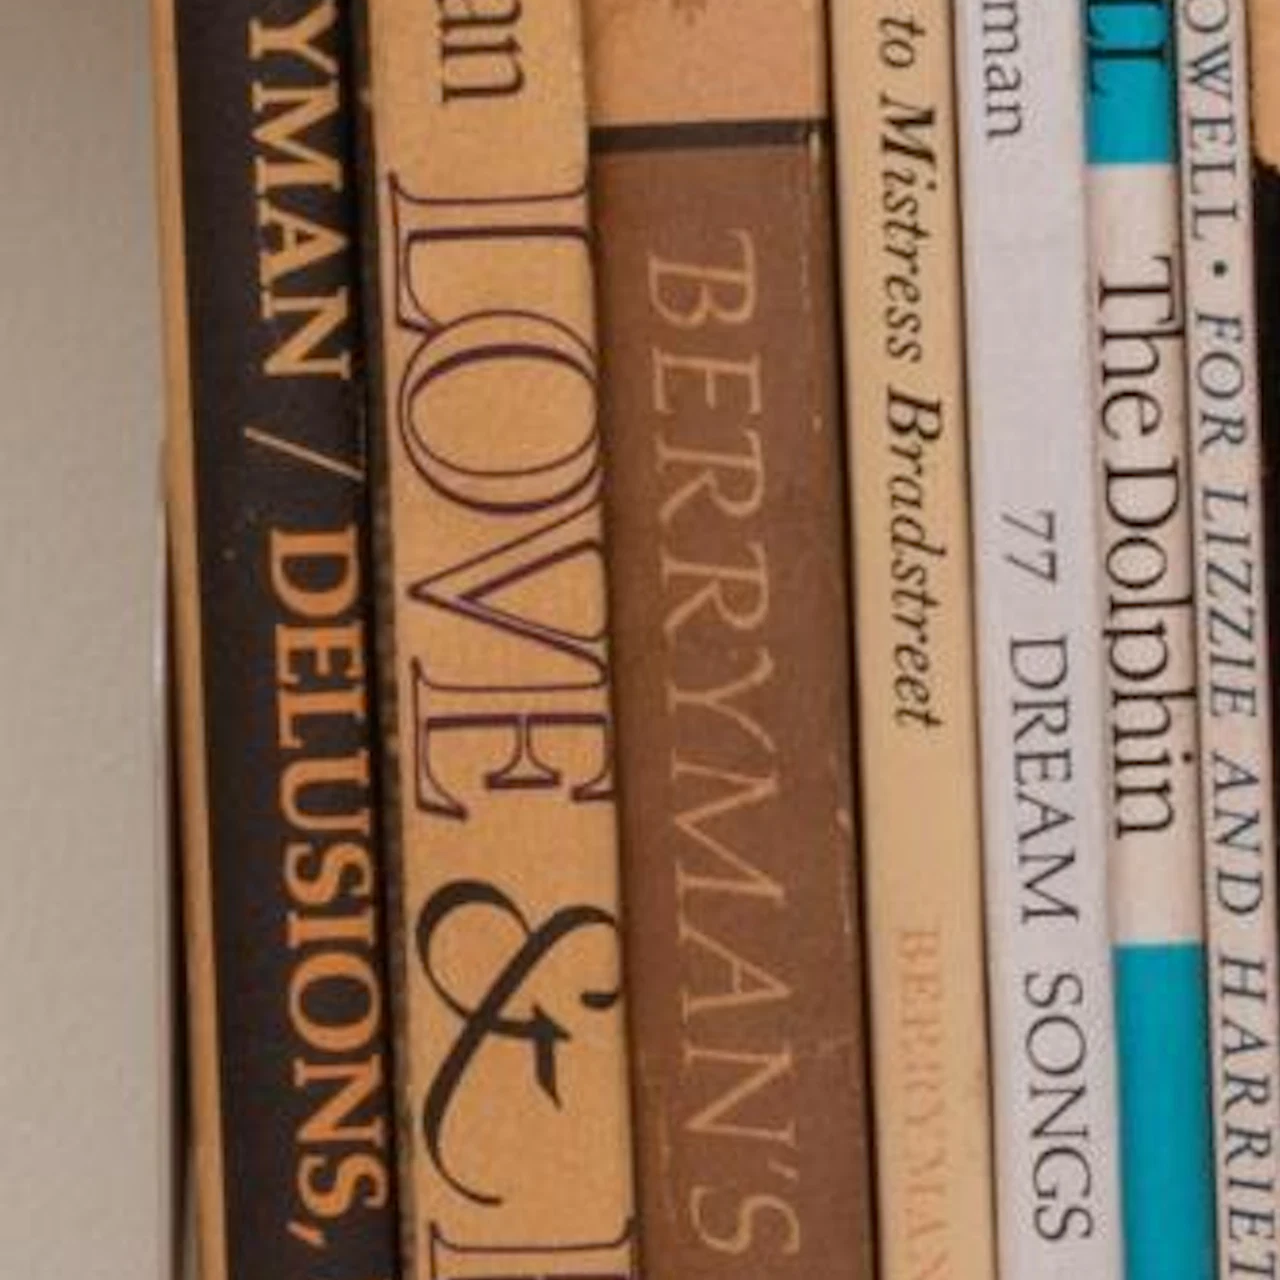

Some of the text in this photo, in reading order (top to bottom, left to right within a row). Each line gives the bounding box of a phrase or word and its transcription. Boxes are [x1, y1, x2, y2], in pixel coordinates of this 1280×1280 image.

[878, 13, 929, 67] to
[879, 94, 937, 364] Mistress
[1194, 310, 1248, 452] FOR
[387, 170, 614, 820] LOVE
[886, 382, 948, 730] Bradstreet
[1098, 255, 1200, 839] The Dolphin
[1202, 486, 1260, 720] LIZZIE
[268, 526, 388, 1245] DELUSIONS,
[647, 227, 800, 1254] BERRYMAN'S
[999, 508, 1094, 1243] 77 DREAM SONGS
[1211, 754, 1264, 917] AND
[414, 877, 621, 1207] &
